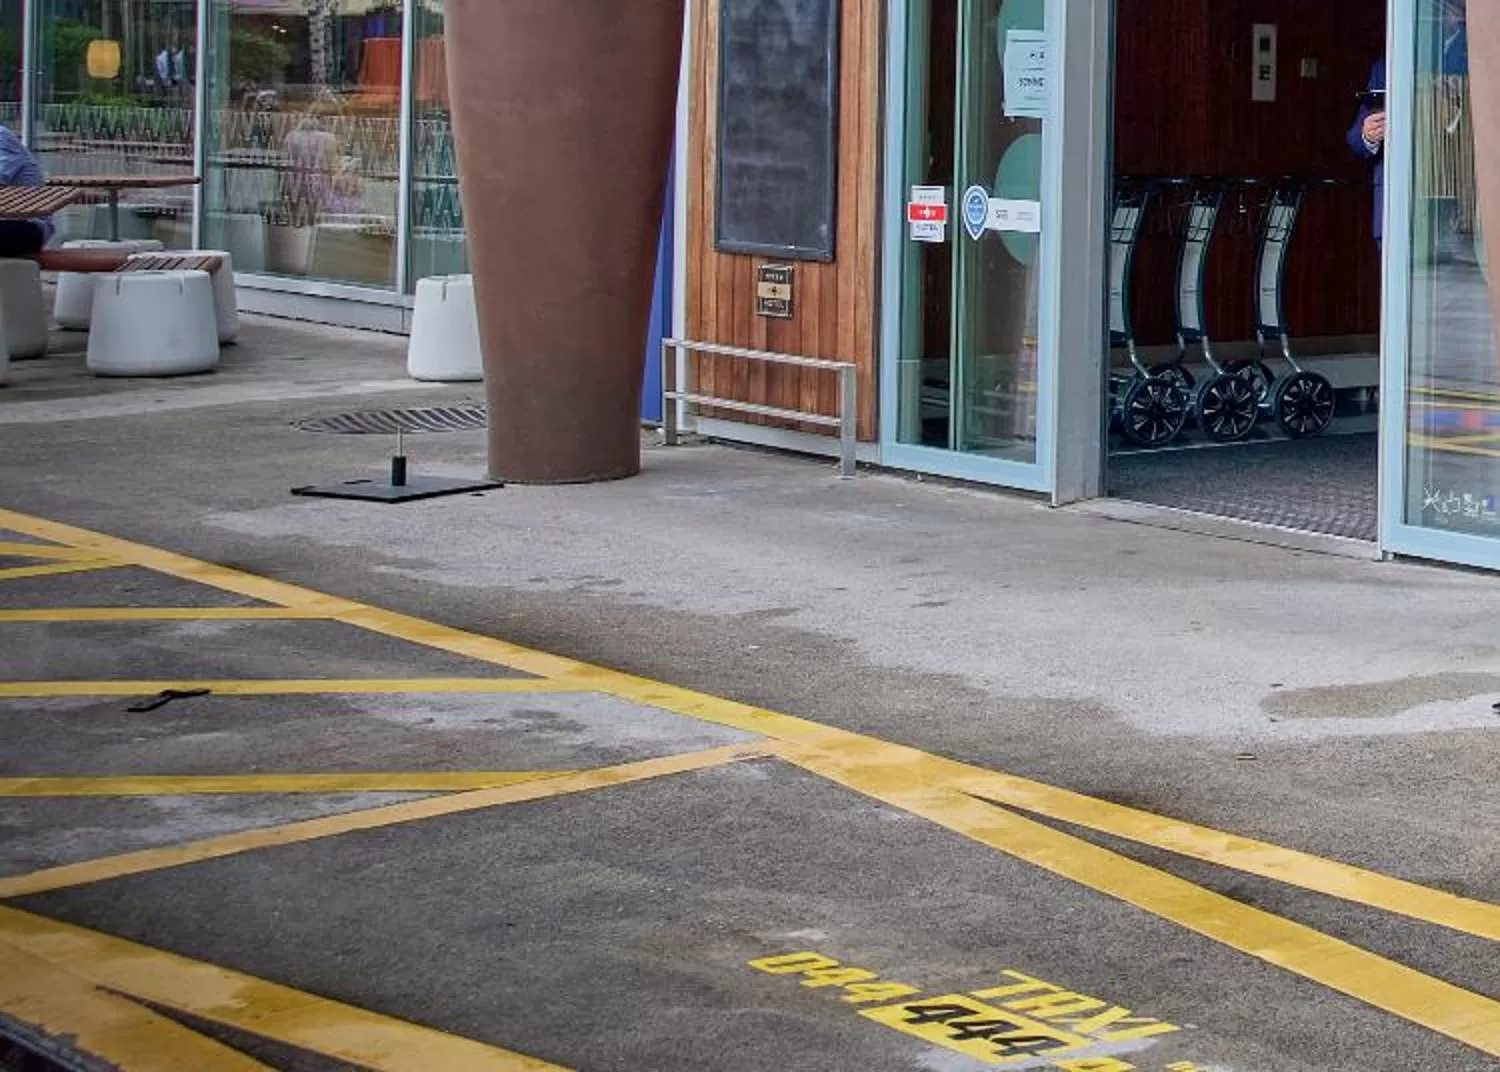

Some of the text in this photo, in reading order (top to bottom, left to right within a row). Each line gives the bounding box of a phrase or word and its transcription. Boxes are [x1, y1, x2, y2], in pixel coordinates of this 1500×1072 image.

[747, 951, 922, 1004] 044
[902, 1003, 1071, 1058] 444
[970, 969, 1181, 1043] TAXI
